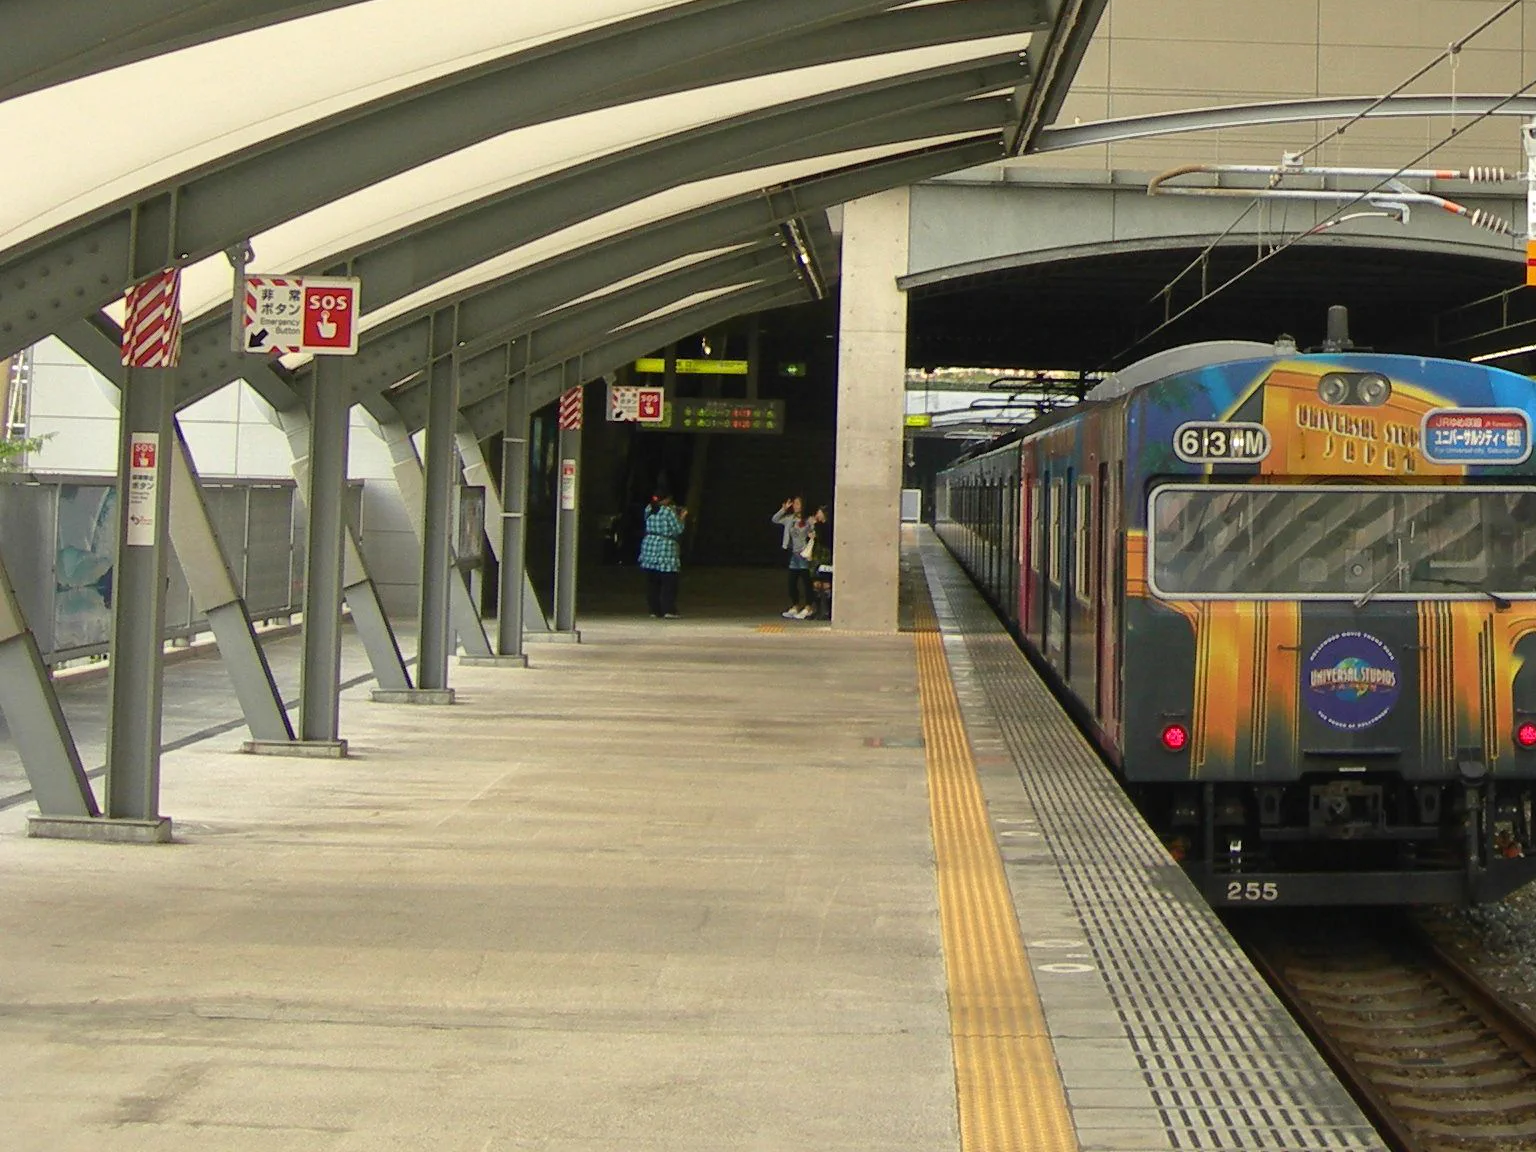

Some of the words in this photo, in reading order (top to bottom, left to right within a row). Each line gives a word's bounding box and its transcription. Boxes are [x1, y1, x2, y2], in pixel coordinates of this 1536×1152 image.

[261, 289, 301, 302] 非常
[261, 303, 300, 315] ボタン
[309, 294, 348, 311] SOS
[261, 317, 300, 327] Emergency
[640, 394, 658, 403] SOS
[1297, 404, 1378, 441] UNIVERSAL
[135, 444, 154, 452] SOS
[1310, 667, 1360, 687] UNIVERSAL
[1360, 667, 1396, 687] STUDIOS
[1227, 881, 1278, 901] 255
